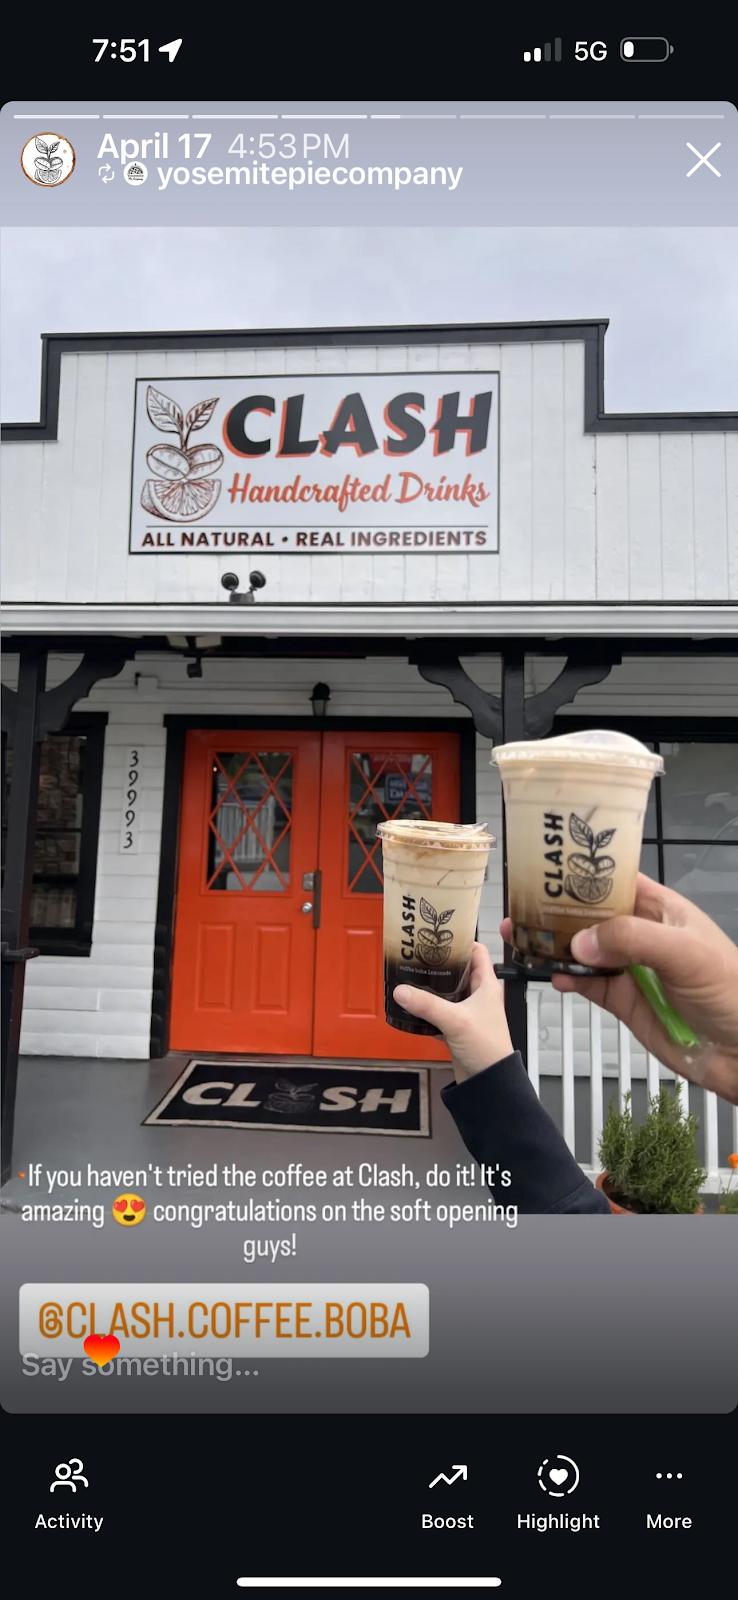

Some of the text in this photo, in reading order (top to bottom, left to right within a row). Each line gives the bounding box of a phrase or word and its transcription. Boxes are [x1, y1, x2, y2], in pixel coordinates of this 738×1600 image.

[222, 391, 493, 458] CLASH
[227, 471, 490, 513] Handcrafted Drinks
[141, 530, 487, 547] ALL NATURAL REAL INGREDIENTS
[123, 750, 139, 849] 39993
[544, 812, 564, 898] CLASH
[400, 895, 416, 960] CLASH
